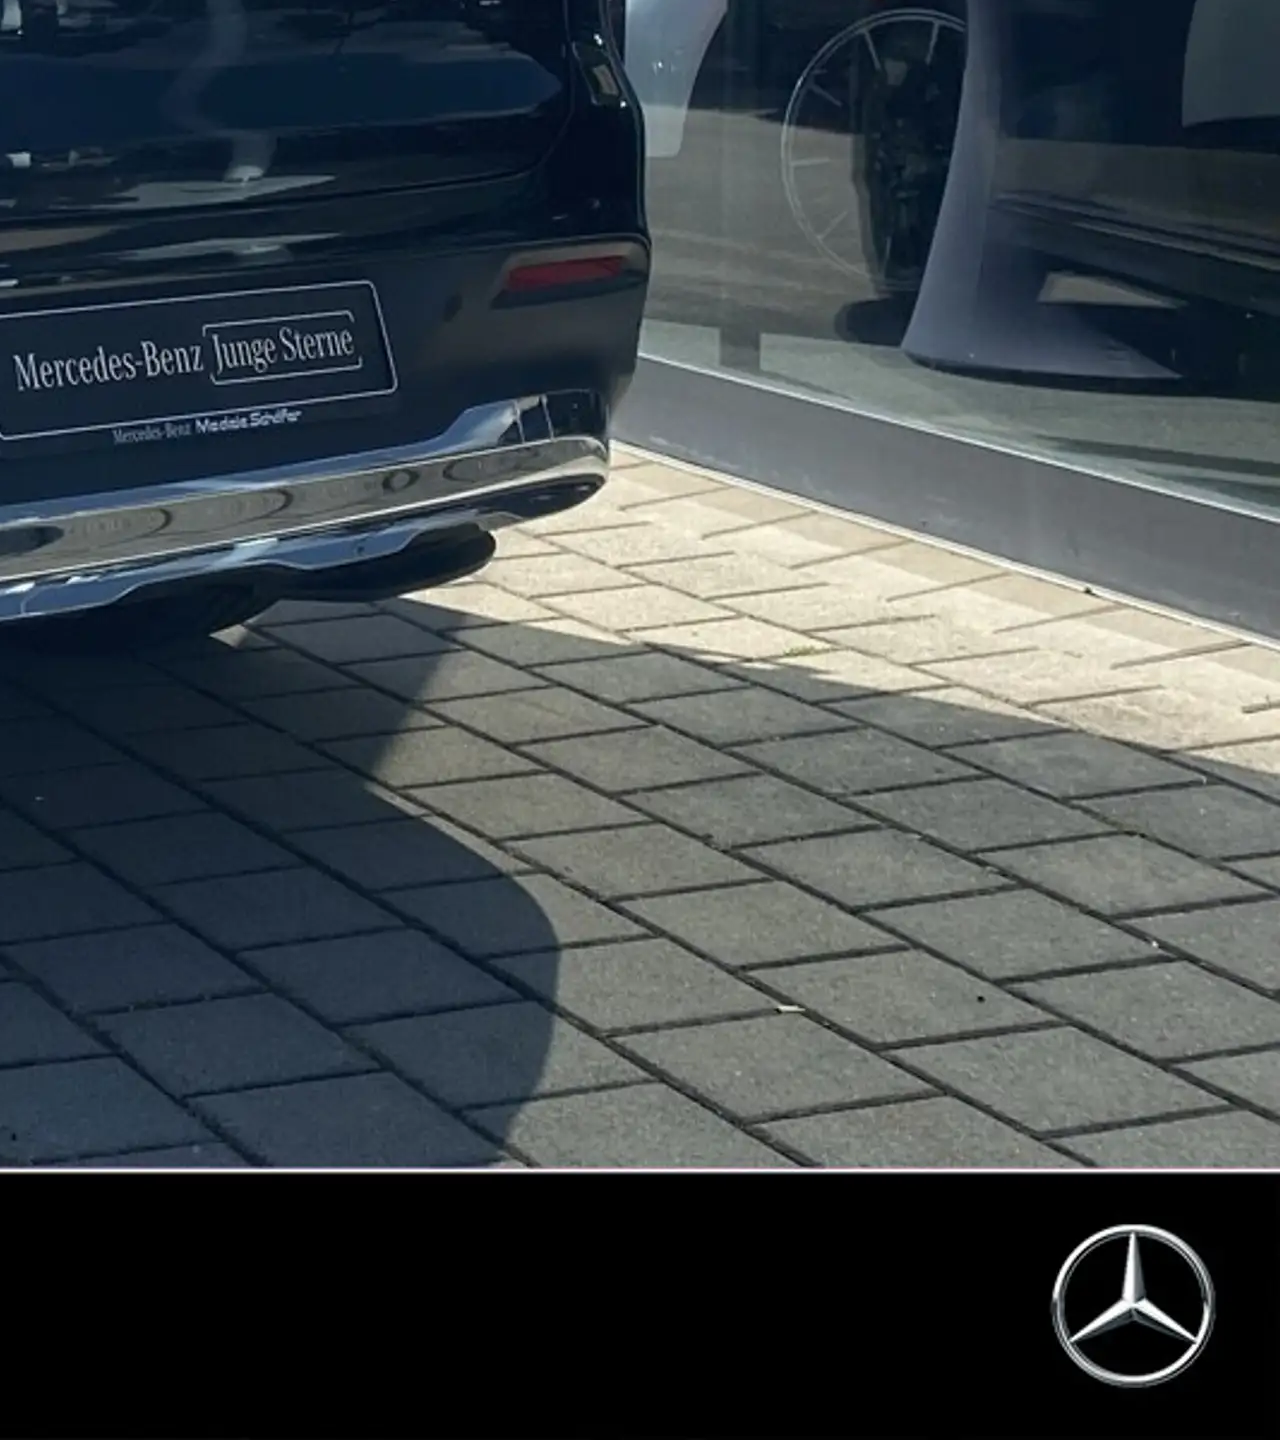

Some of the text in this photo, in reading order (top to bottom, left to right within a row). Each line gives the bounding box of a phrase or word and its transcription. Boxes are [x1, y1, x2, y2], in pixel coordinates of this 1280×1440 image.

[13, 325, 355, 392] Mercedes-Benz Junge Sterne
